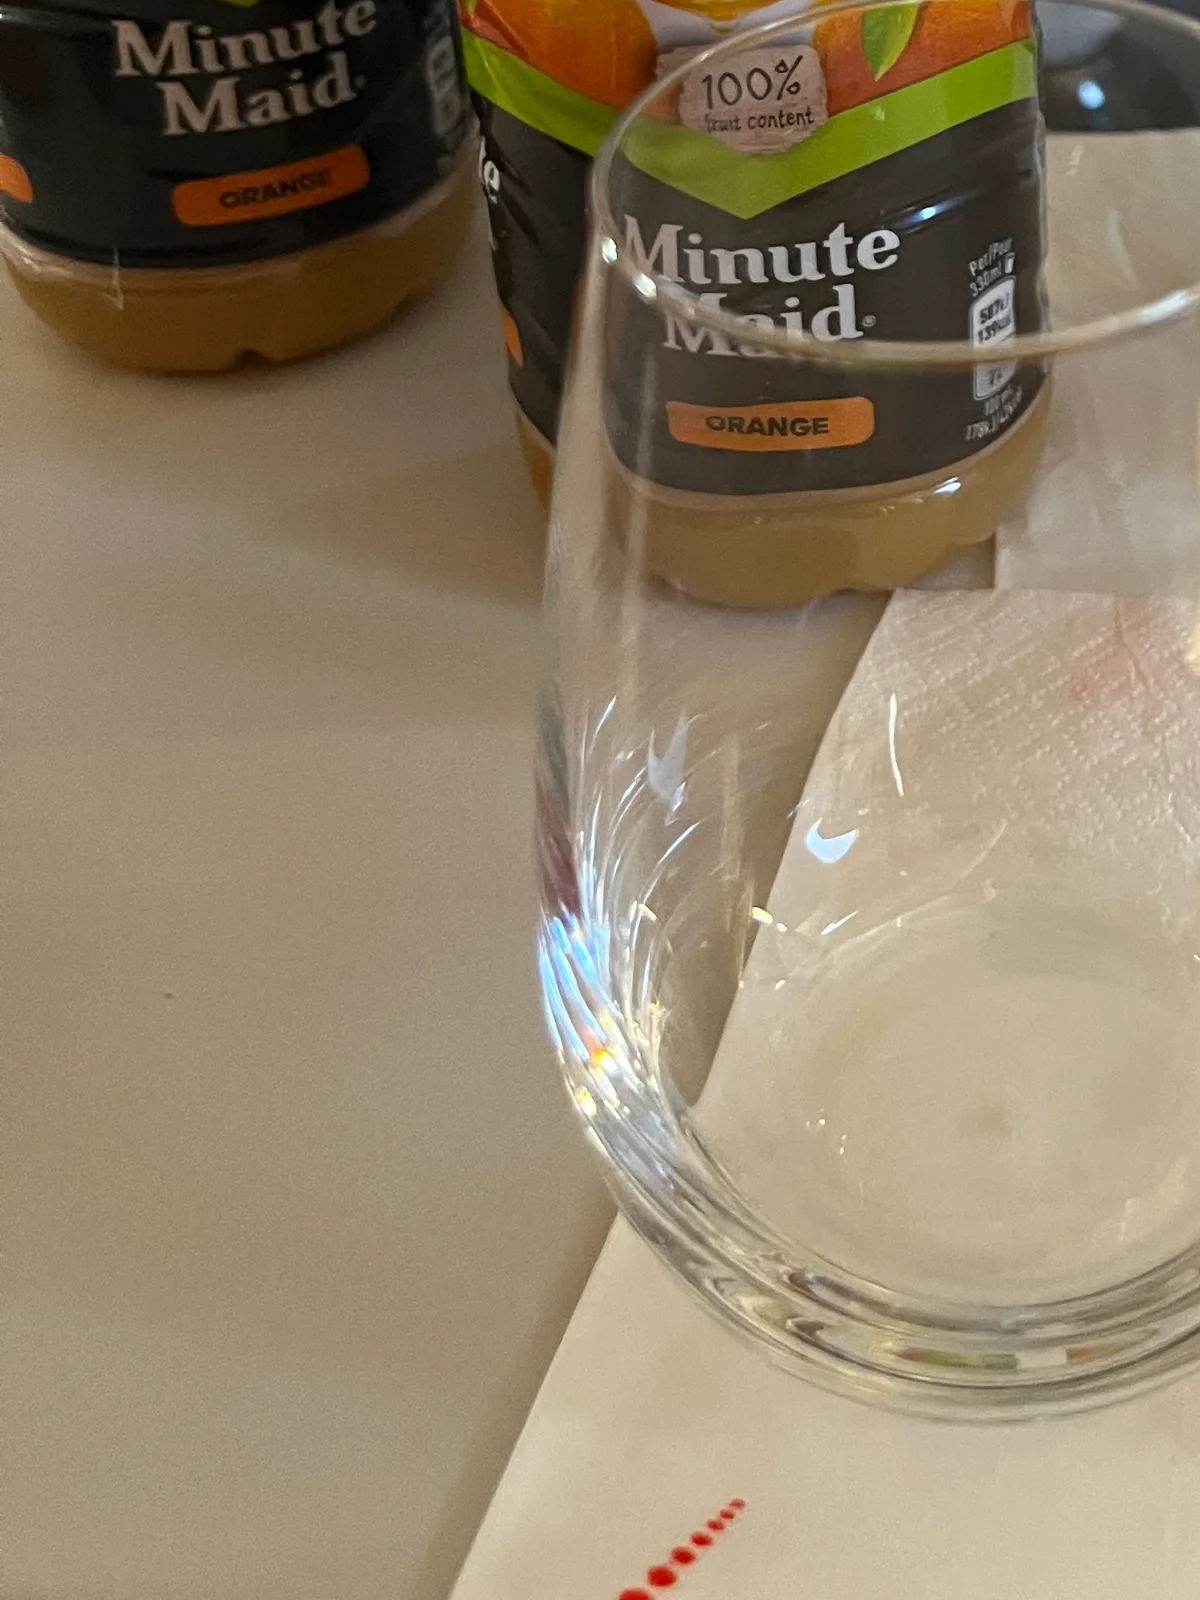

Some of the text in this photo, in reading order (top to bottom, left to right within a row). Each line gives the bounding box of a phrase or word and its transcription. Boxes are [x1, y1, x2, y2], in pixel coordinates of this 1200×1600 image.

[156, 51, 359, 136] Maid
[702, 55, 804, 110] 100%
[705, 106, 815, 135] fruit content
[219, 167, 333, 210] ORANGE
[623, 214, 900, 287] Minute
[705, 413, 831, 437] ORANGE
